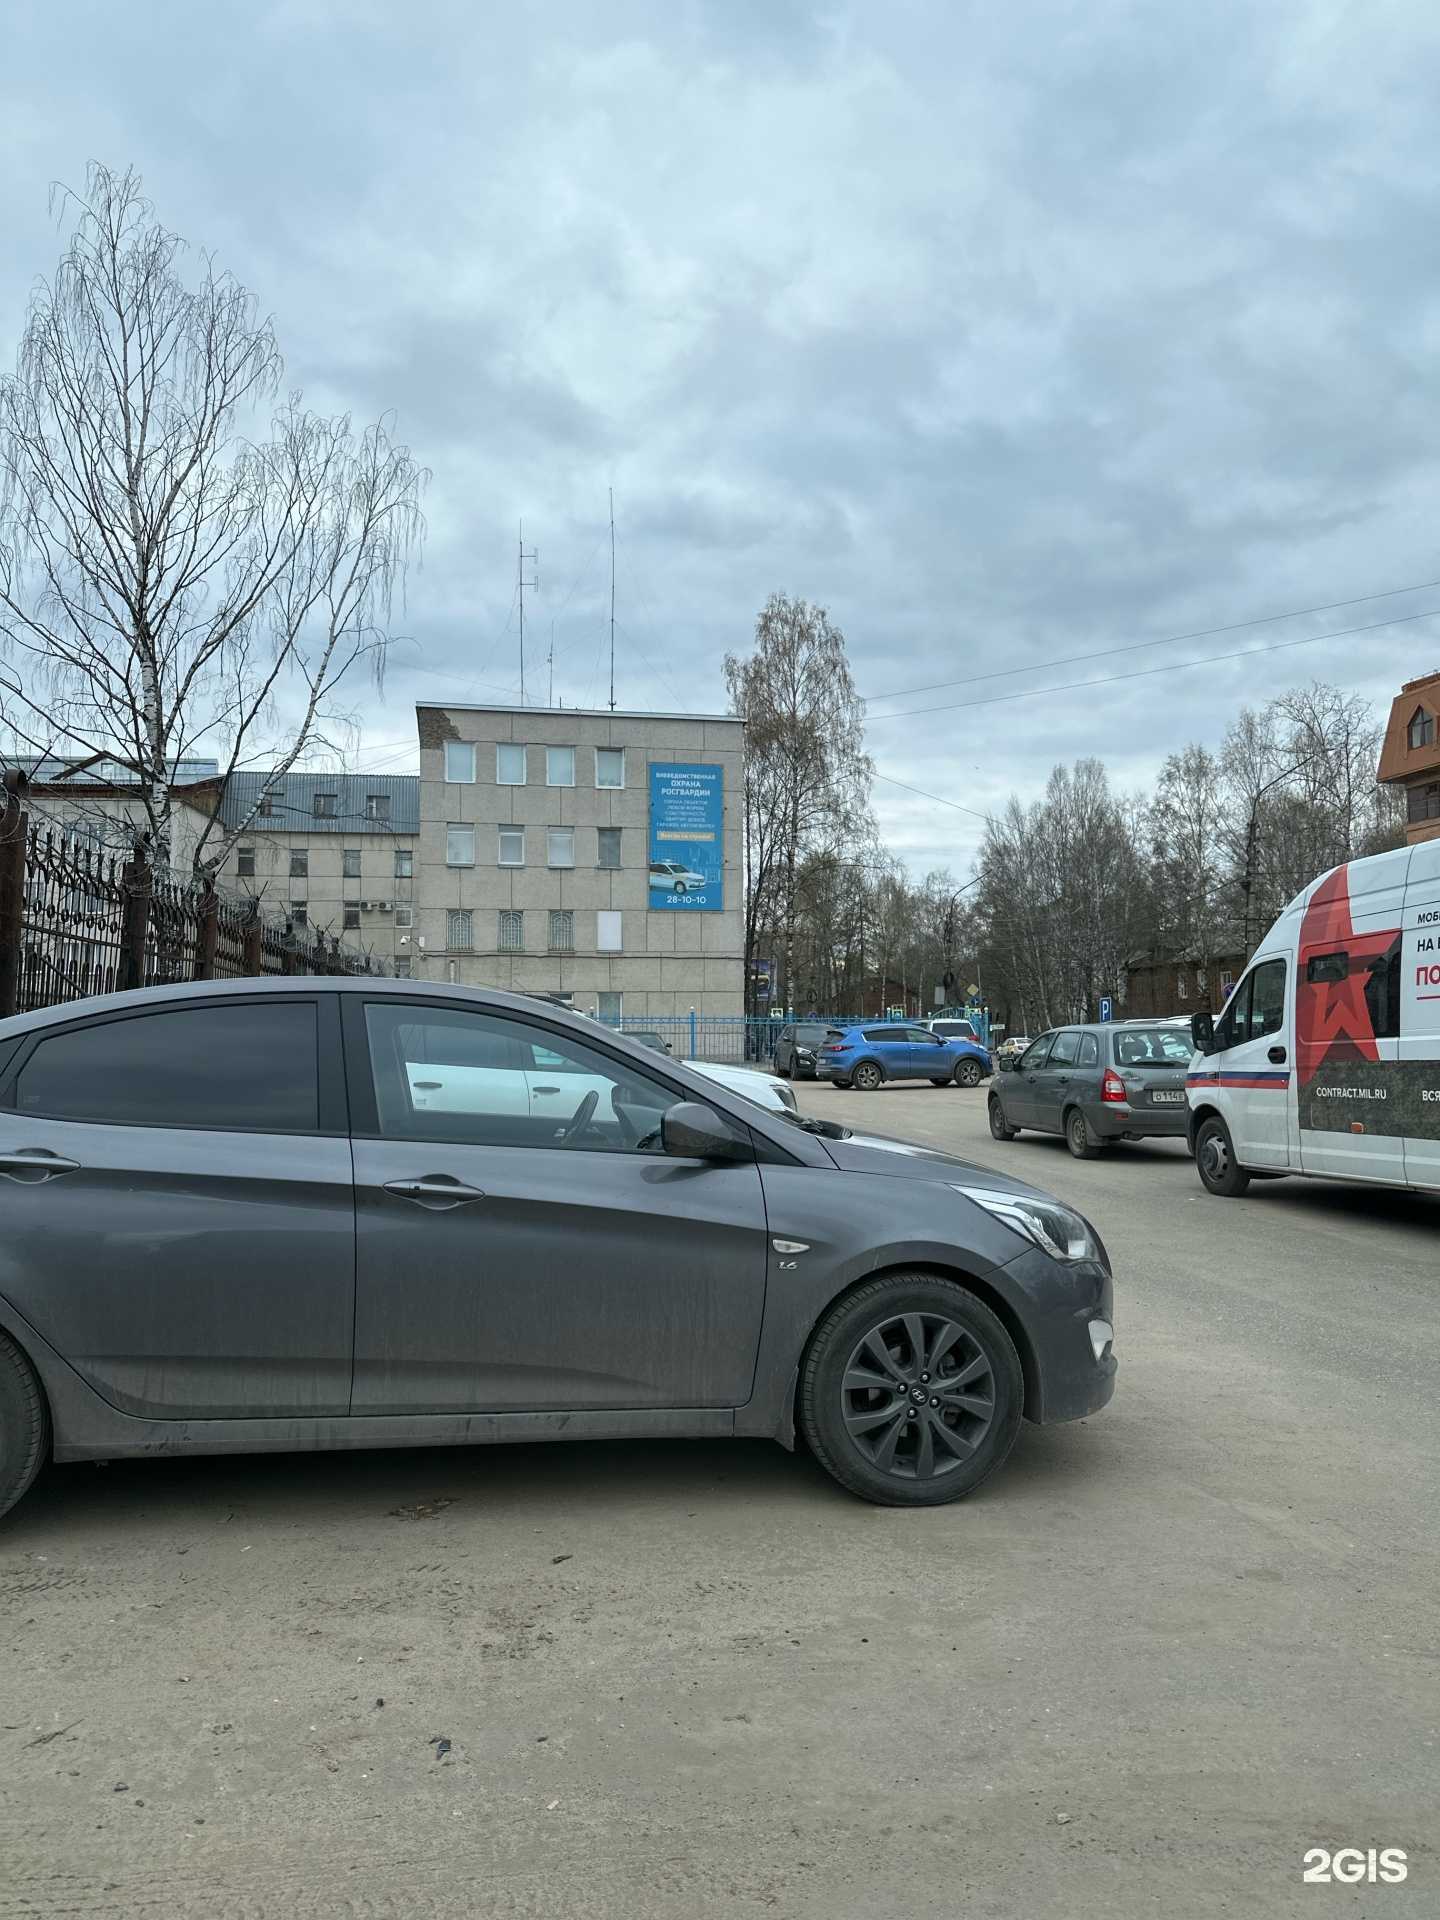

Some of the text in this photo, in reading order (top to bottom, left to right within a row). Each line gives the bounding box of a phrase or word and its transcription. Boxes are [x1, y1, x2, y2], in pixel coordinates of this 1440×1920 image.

[671, 779, 701, 788] ОХРАНА
[661, 787, 710, 797] РОСГВАРДИИ
[666, 895, 707, 905] 28-10-10
[1417, 911, 1440, 924] МОБ
[1417, 938, 1434, 952] НА
[1102, 1001, 1109, 1021] P
[1316, 1087, 1387, 1100] CONTRACT.MIL.RU
